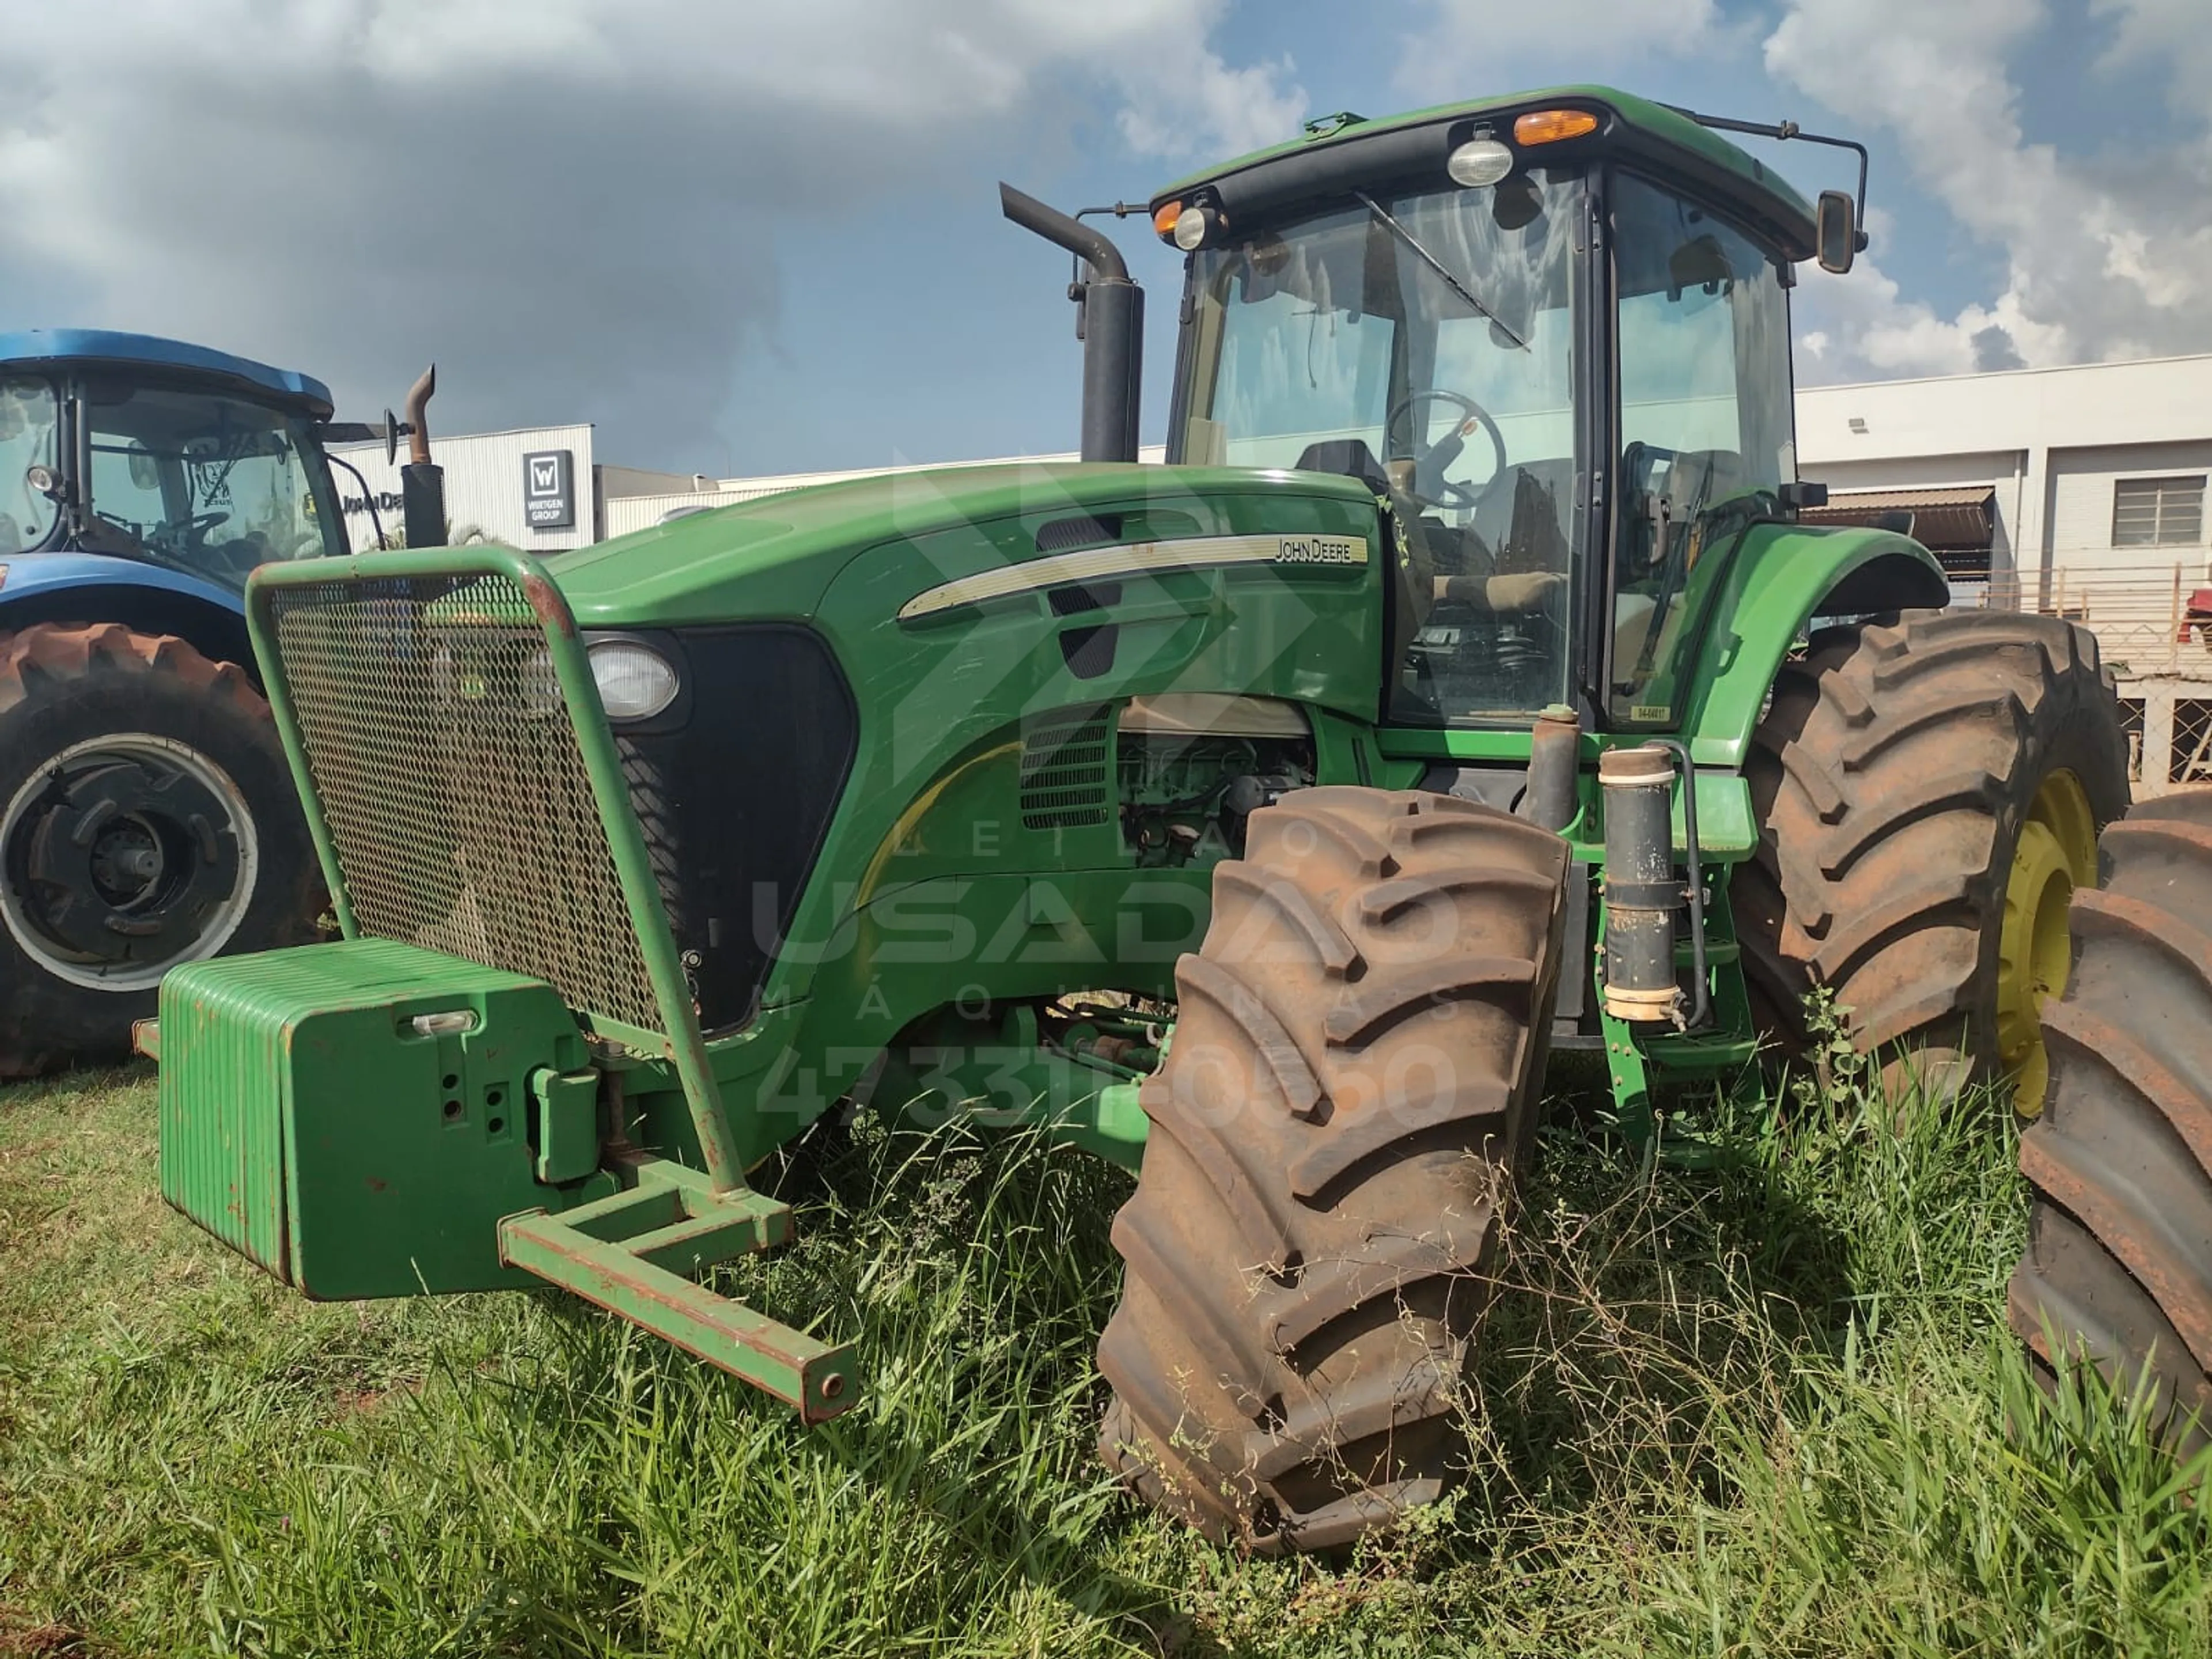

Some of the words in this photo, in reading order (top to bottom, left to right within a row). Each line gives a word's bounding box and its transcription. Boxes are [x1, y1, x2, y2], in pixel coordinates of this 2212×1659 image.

[533, 465, 554, 486] W
[532, 510, 560, 521] GROUP
[1275, 538, 1310, 562] JOHN
[1312, 539, 1350, 561] DEERE
